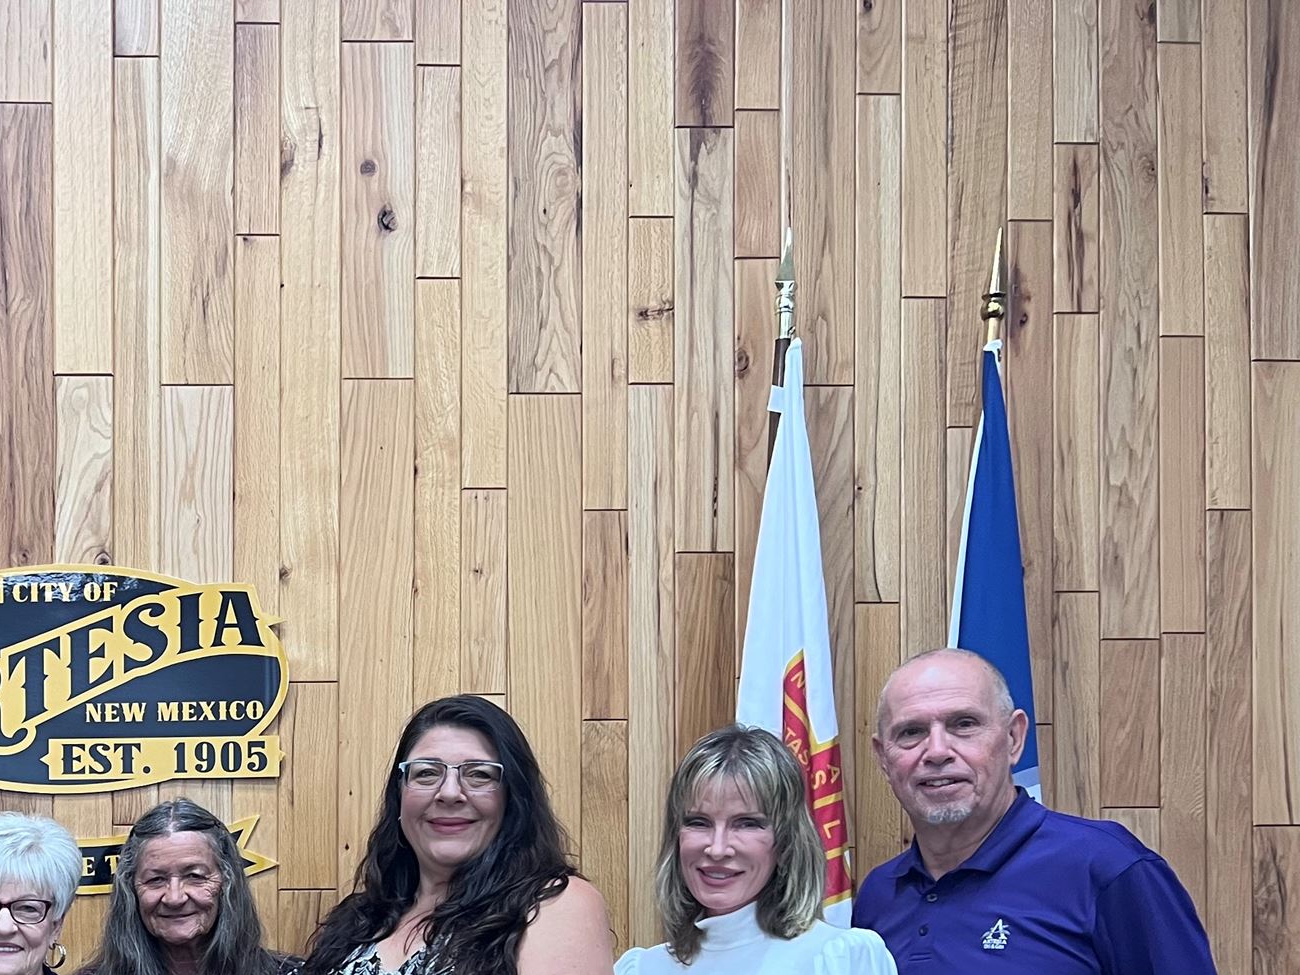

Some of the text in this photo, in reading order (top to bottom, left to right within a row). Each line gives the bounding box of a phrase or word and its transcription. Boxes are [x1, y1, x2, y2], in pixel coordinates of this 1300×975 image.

[11, 581, 118, 603] CITY OF
[85, 700, 265, 724] NEW MEXICO
[60, 741, 268, 775] EST. 1905
